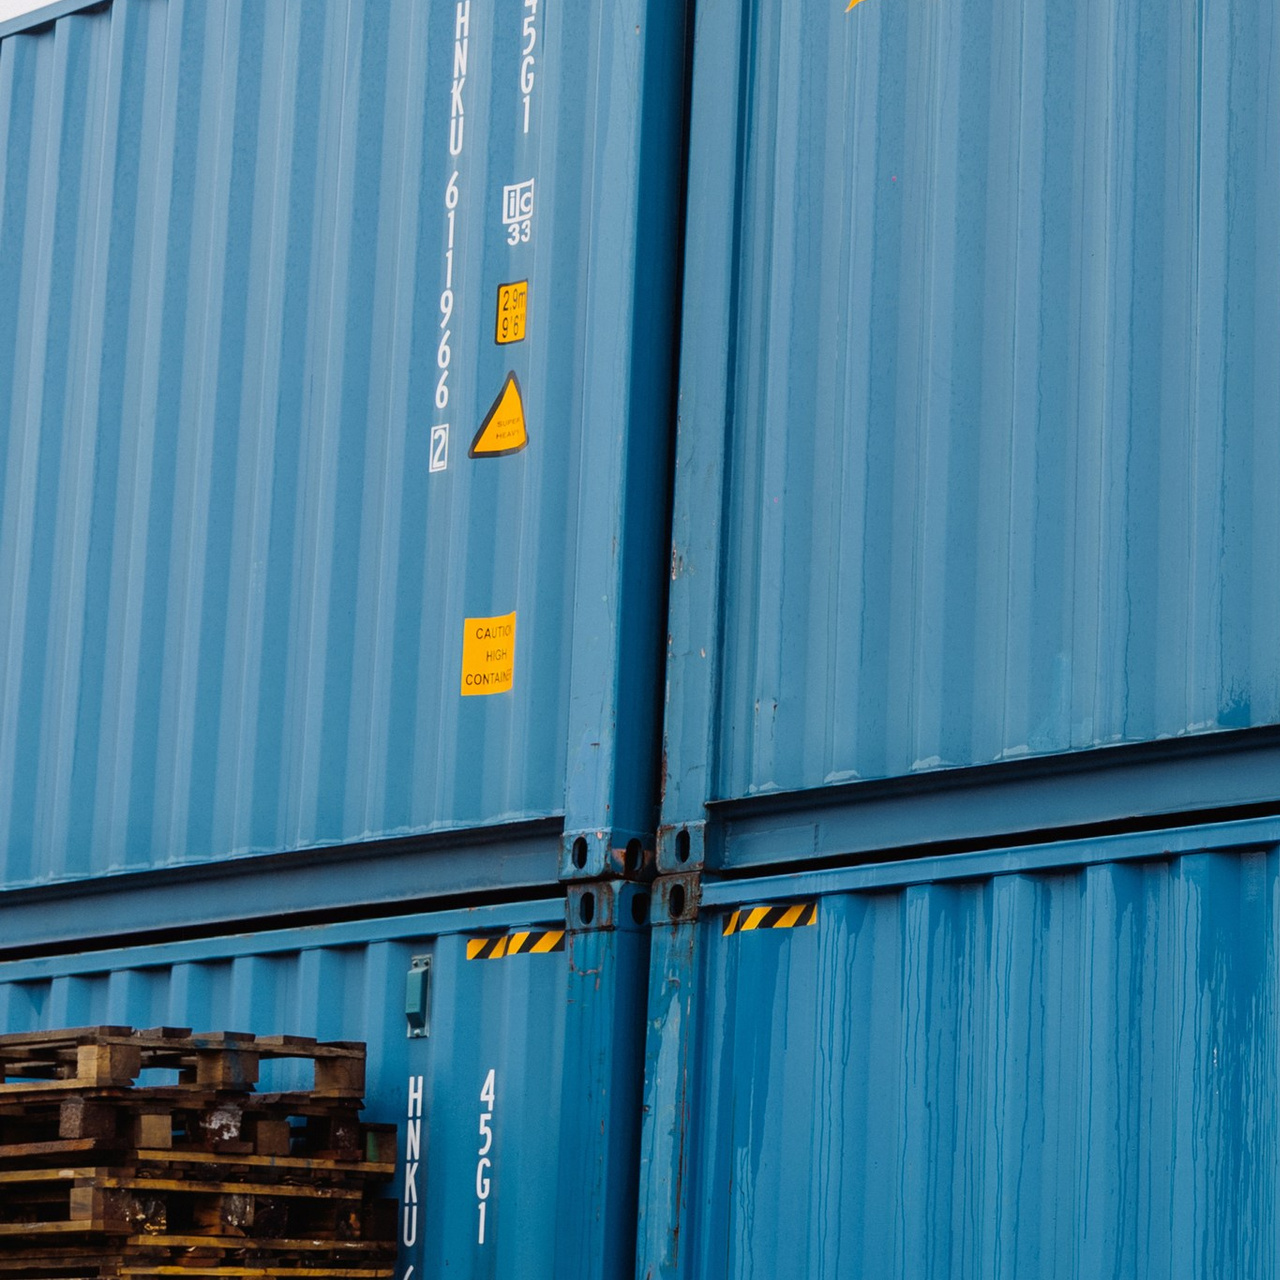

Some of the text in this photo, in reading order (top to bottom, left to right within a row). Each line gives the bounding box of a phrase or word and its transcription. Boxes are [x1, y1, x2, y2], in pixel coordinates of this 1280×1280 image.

[431, 0, 471, 469] HNKU 611966 2
[507, 219, 531, 246] 33
[475, 624, 512, 640] CAUTIO
[486, 648, 508, 662] HIGH
[465, 667, 512, 686] CONTAINE
[403, 1075, 424, 1247] HNKU
[476, 1068, 496, 1245] 45G1
